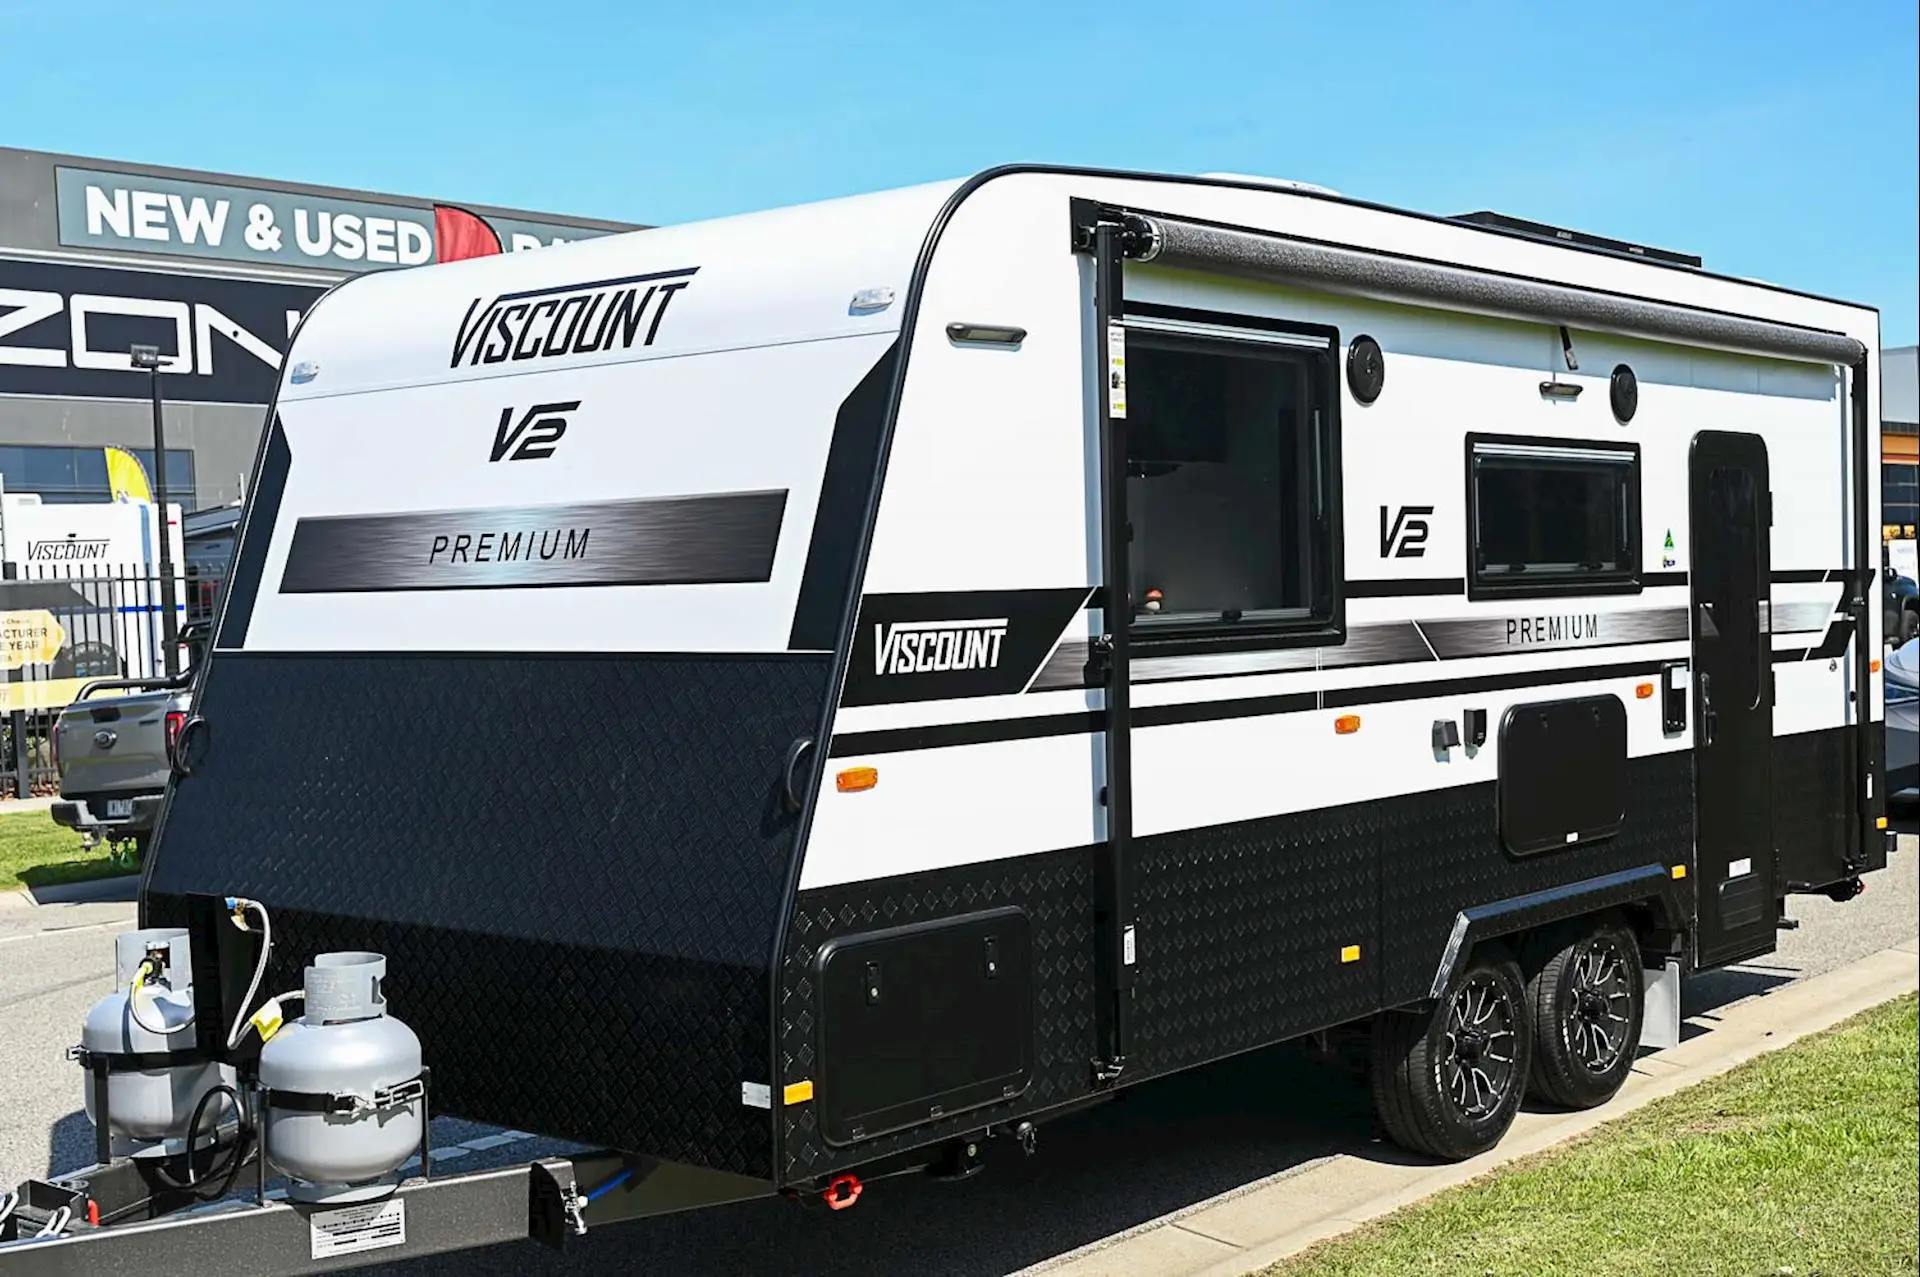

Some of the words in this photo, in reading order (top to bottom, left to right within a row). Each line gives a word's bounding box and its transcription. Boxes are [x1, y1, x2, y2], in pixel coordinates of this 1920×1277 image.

[85, 185, 230, 247] NEW
[243, 203, 283, 252] &
[294, 208, 432, 266] USED
[450, 266, 701, 369] VISCOUNT
[489, 400, 582, 462] V2
[28, 538, 110, 560] VISCOUNT
[429, 528, 591, 564] PREMIUM
[1380, 505, 1434, 558] V2
[875, 617, 1009, 676] VISCOUNT
[1506, 614, 1598, 645] PREMIUM
